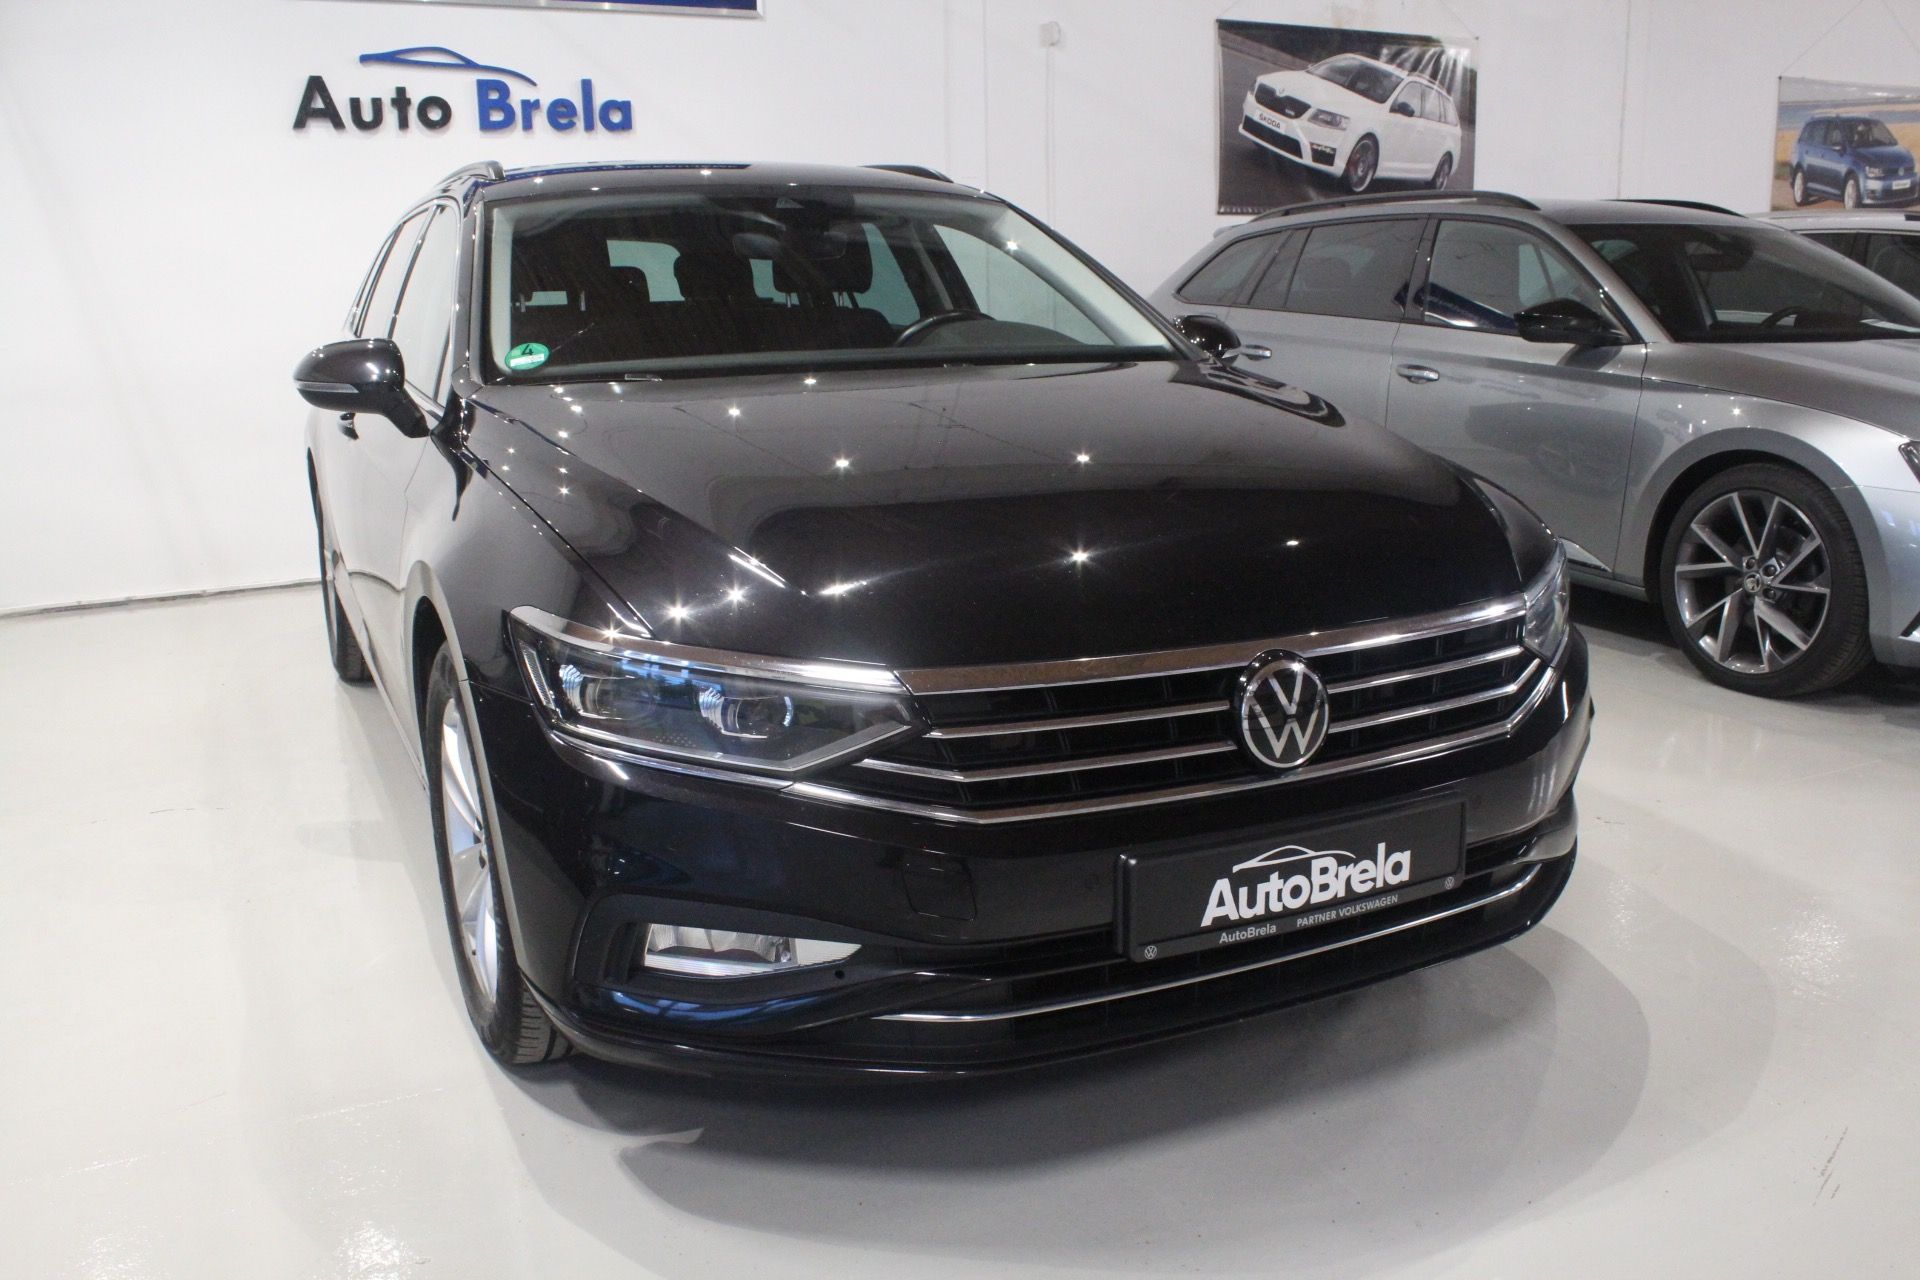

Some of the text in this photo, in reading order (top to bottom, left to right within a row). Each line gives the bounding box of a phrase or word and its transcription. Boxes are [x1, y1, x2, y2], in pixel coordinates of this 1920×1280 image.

[293, 75, 633, 131] Auto Brela
[1200, 842, 1411, 927] AutoBrela
[1219, 923, 1277, 944] AutoBrela
[1296, 894, 1399, 928] PARTNER VOLKSWAGEN
